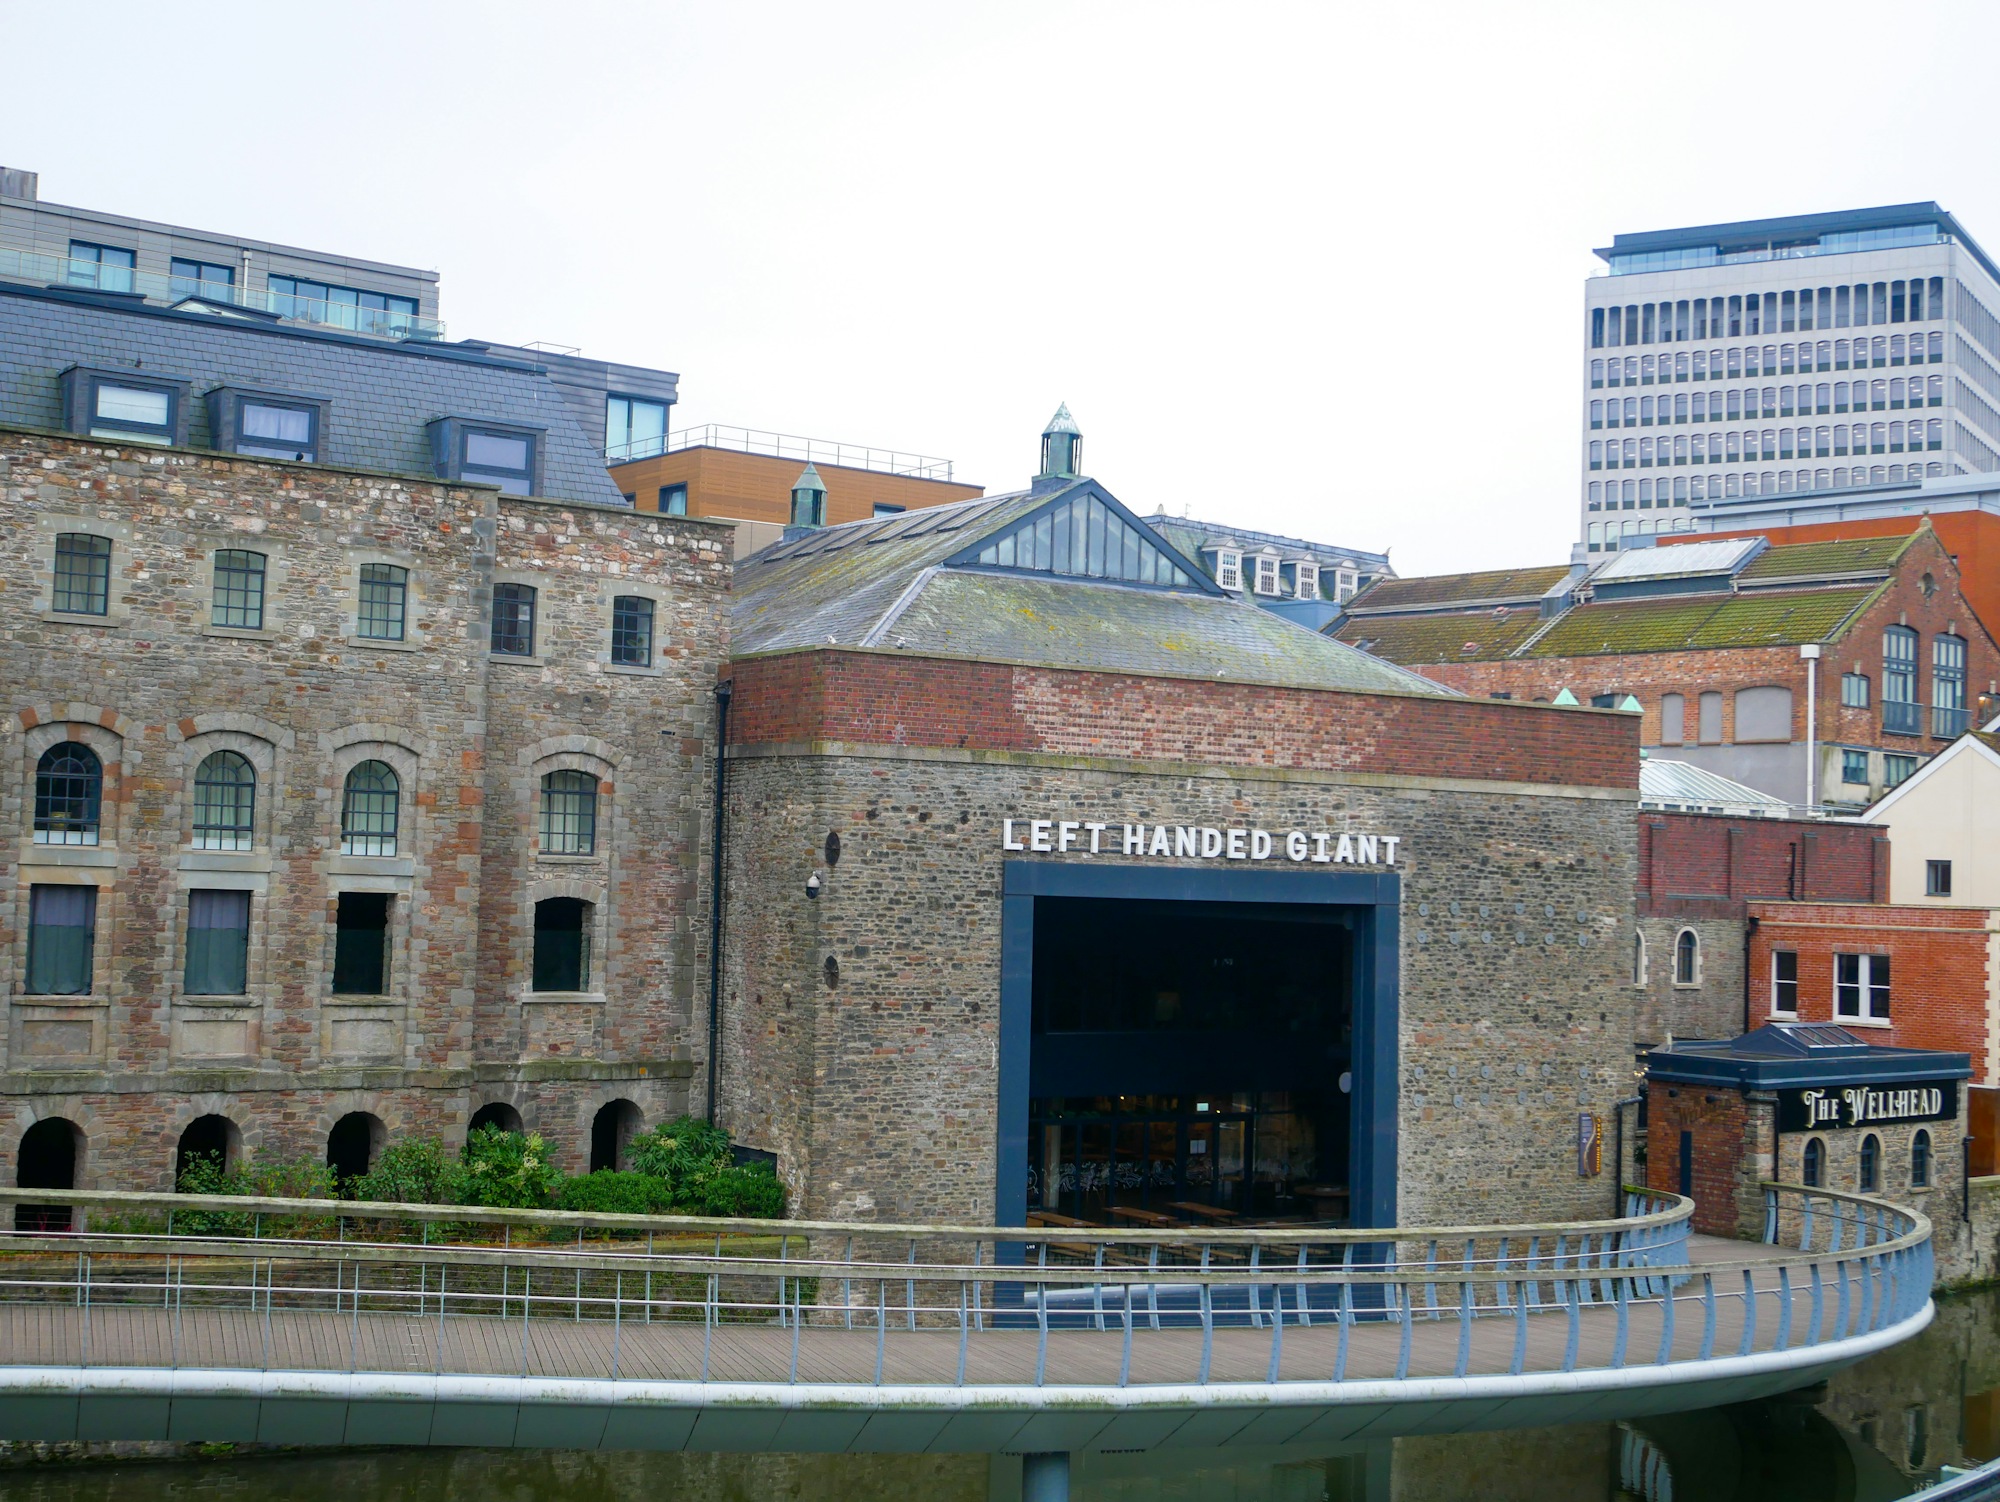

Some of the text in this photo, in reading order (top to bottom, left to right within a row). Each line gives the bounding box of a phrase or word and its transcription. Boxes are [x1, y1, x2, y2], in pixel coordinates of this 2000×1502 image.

[1003, 818, 1400, 865] LEFT HANDED GIANT
[1802, 1086, 1943, 1128] THE WELLHEAD
